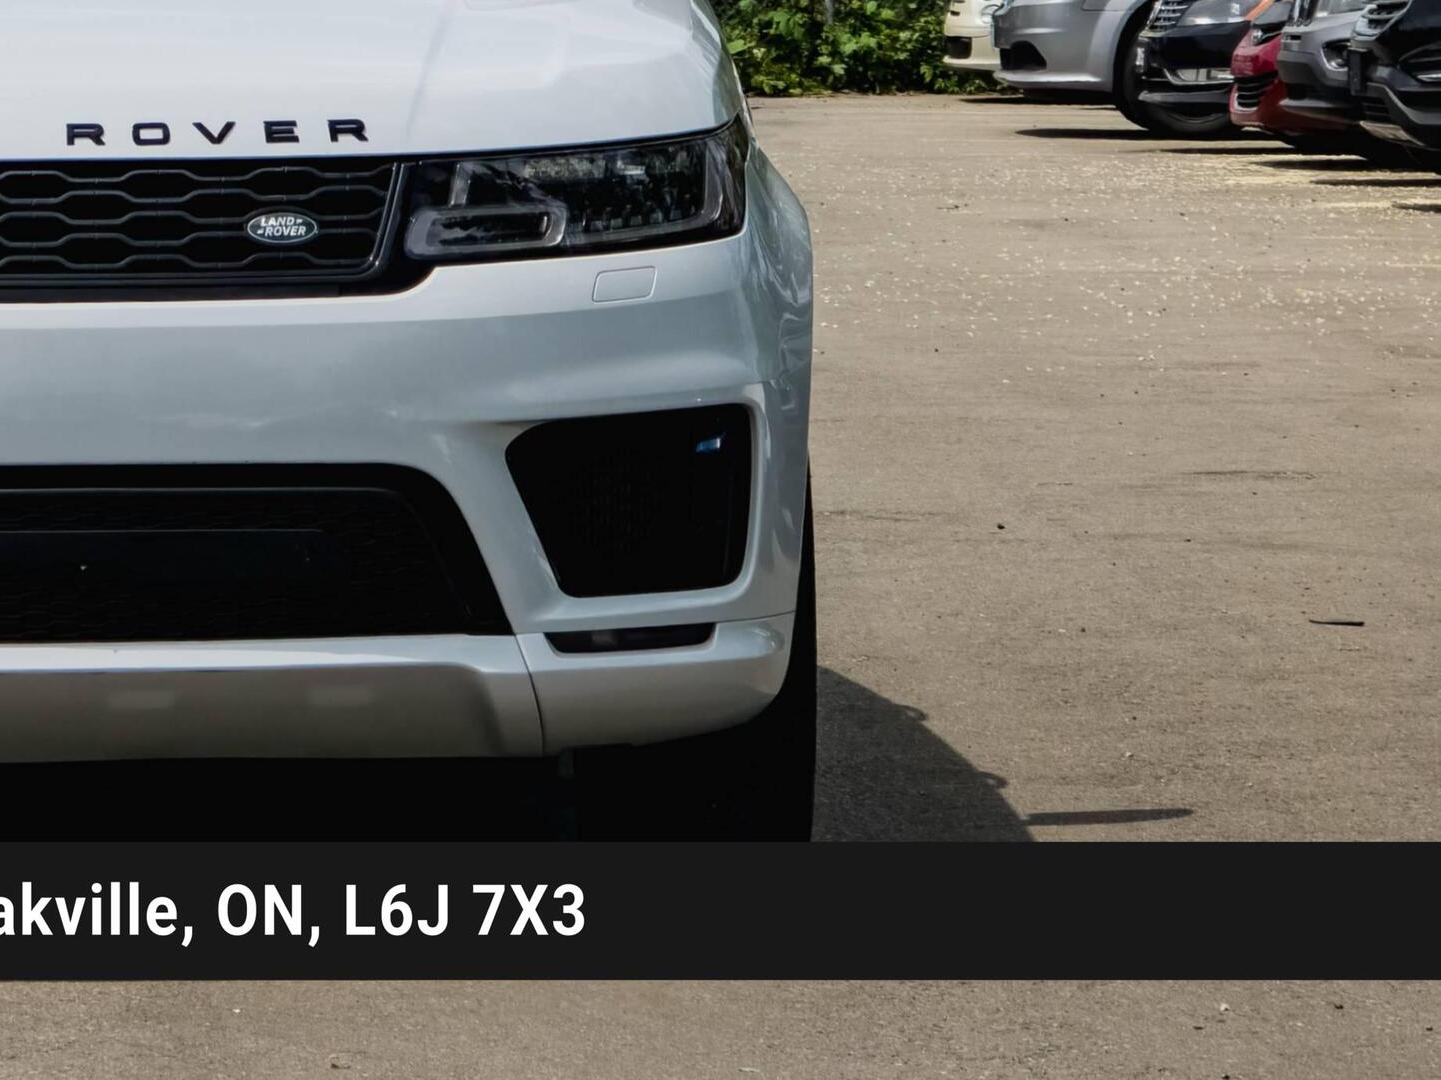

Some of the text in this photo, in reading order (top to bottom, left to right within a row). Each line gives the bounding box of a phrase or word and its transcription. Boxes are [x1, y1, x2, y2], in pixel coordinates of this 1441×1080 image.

[66, 119, 368, 146] ROVER
[260, 216, 295, 226] LAND
[264, 226, 307, 236] ROVER
